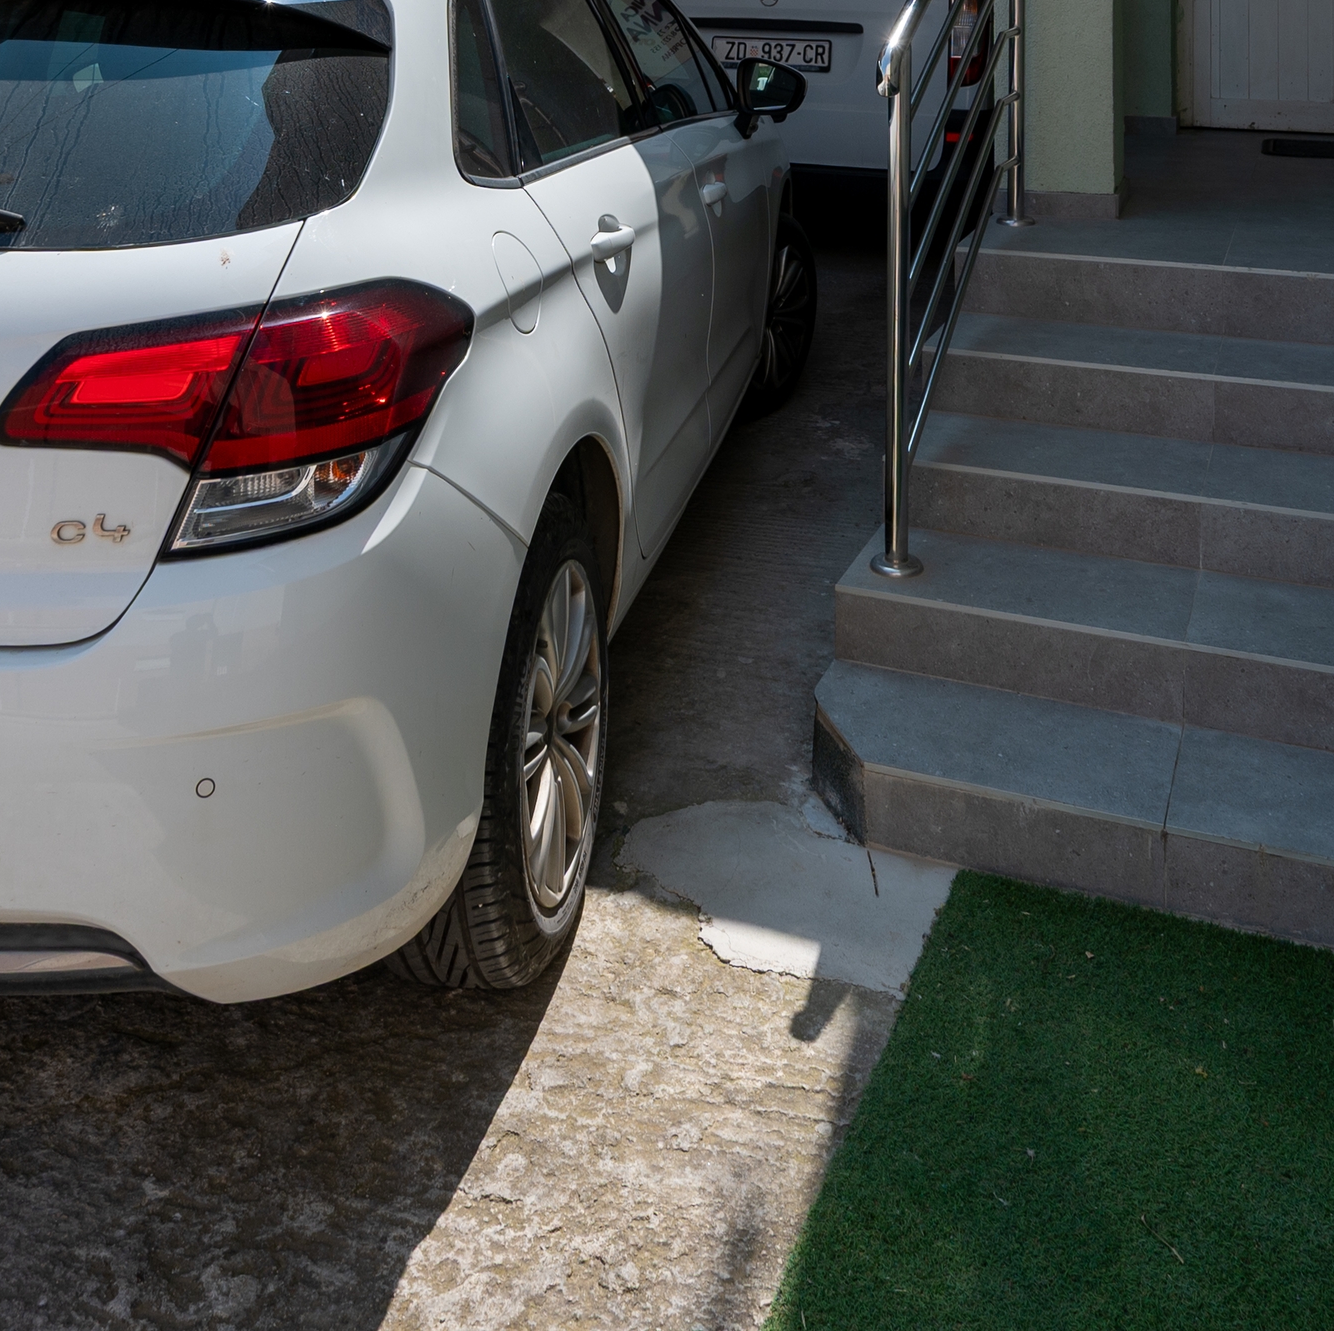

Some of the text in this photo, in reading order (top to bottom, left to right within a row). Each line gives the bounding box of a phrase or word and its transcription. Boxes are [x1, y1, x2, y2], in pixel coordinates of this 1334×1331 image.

[724, 41, 826, 65] ZD 937-CR
[49, 512, 131, 545] C4
